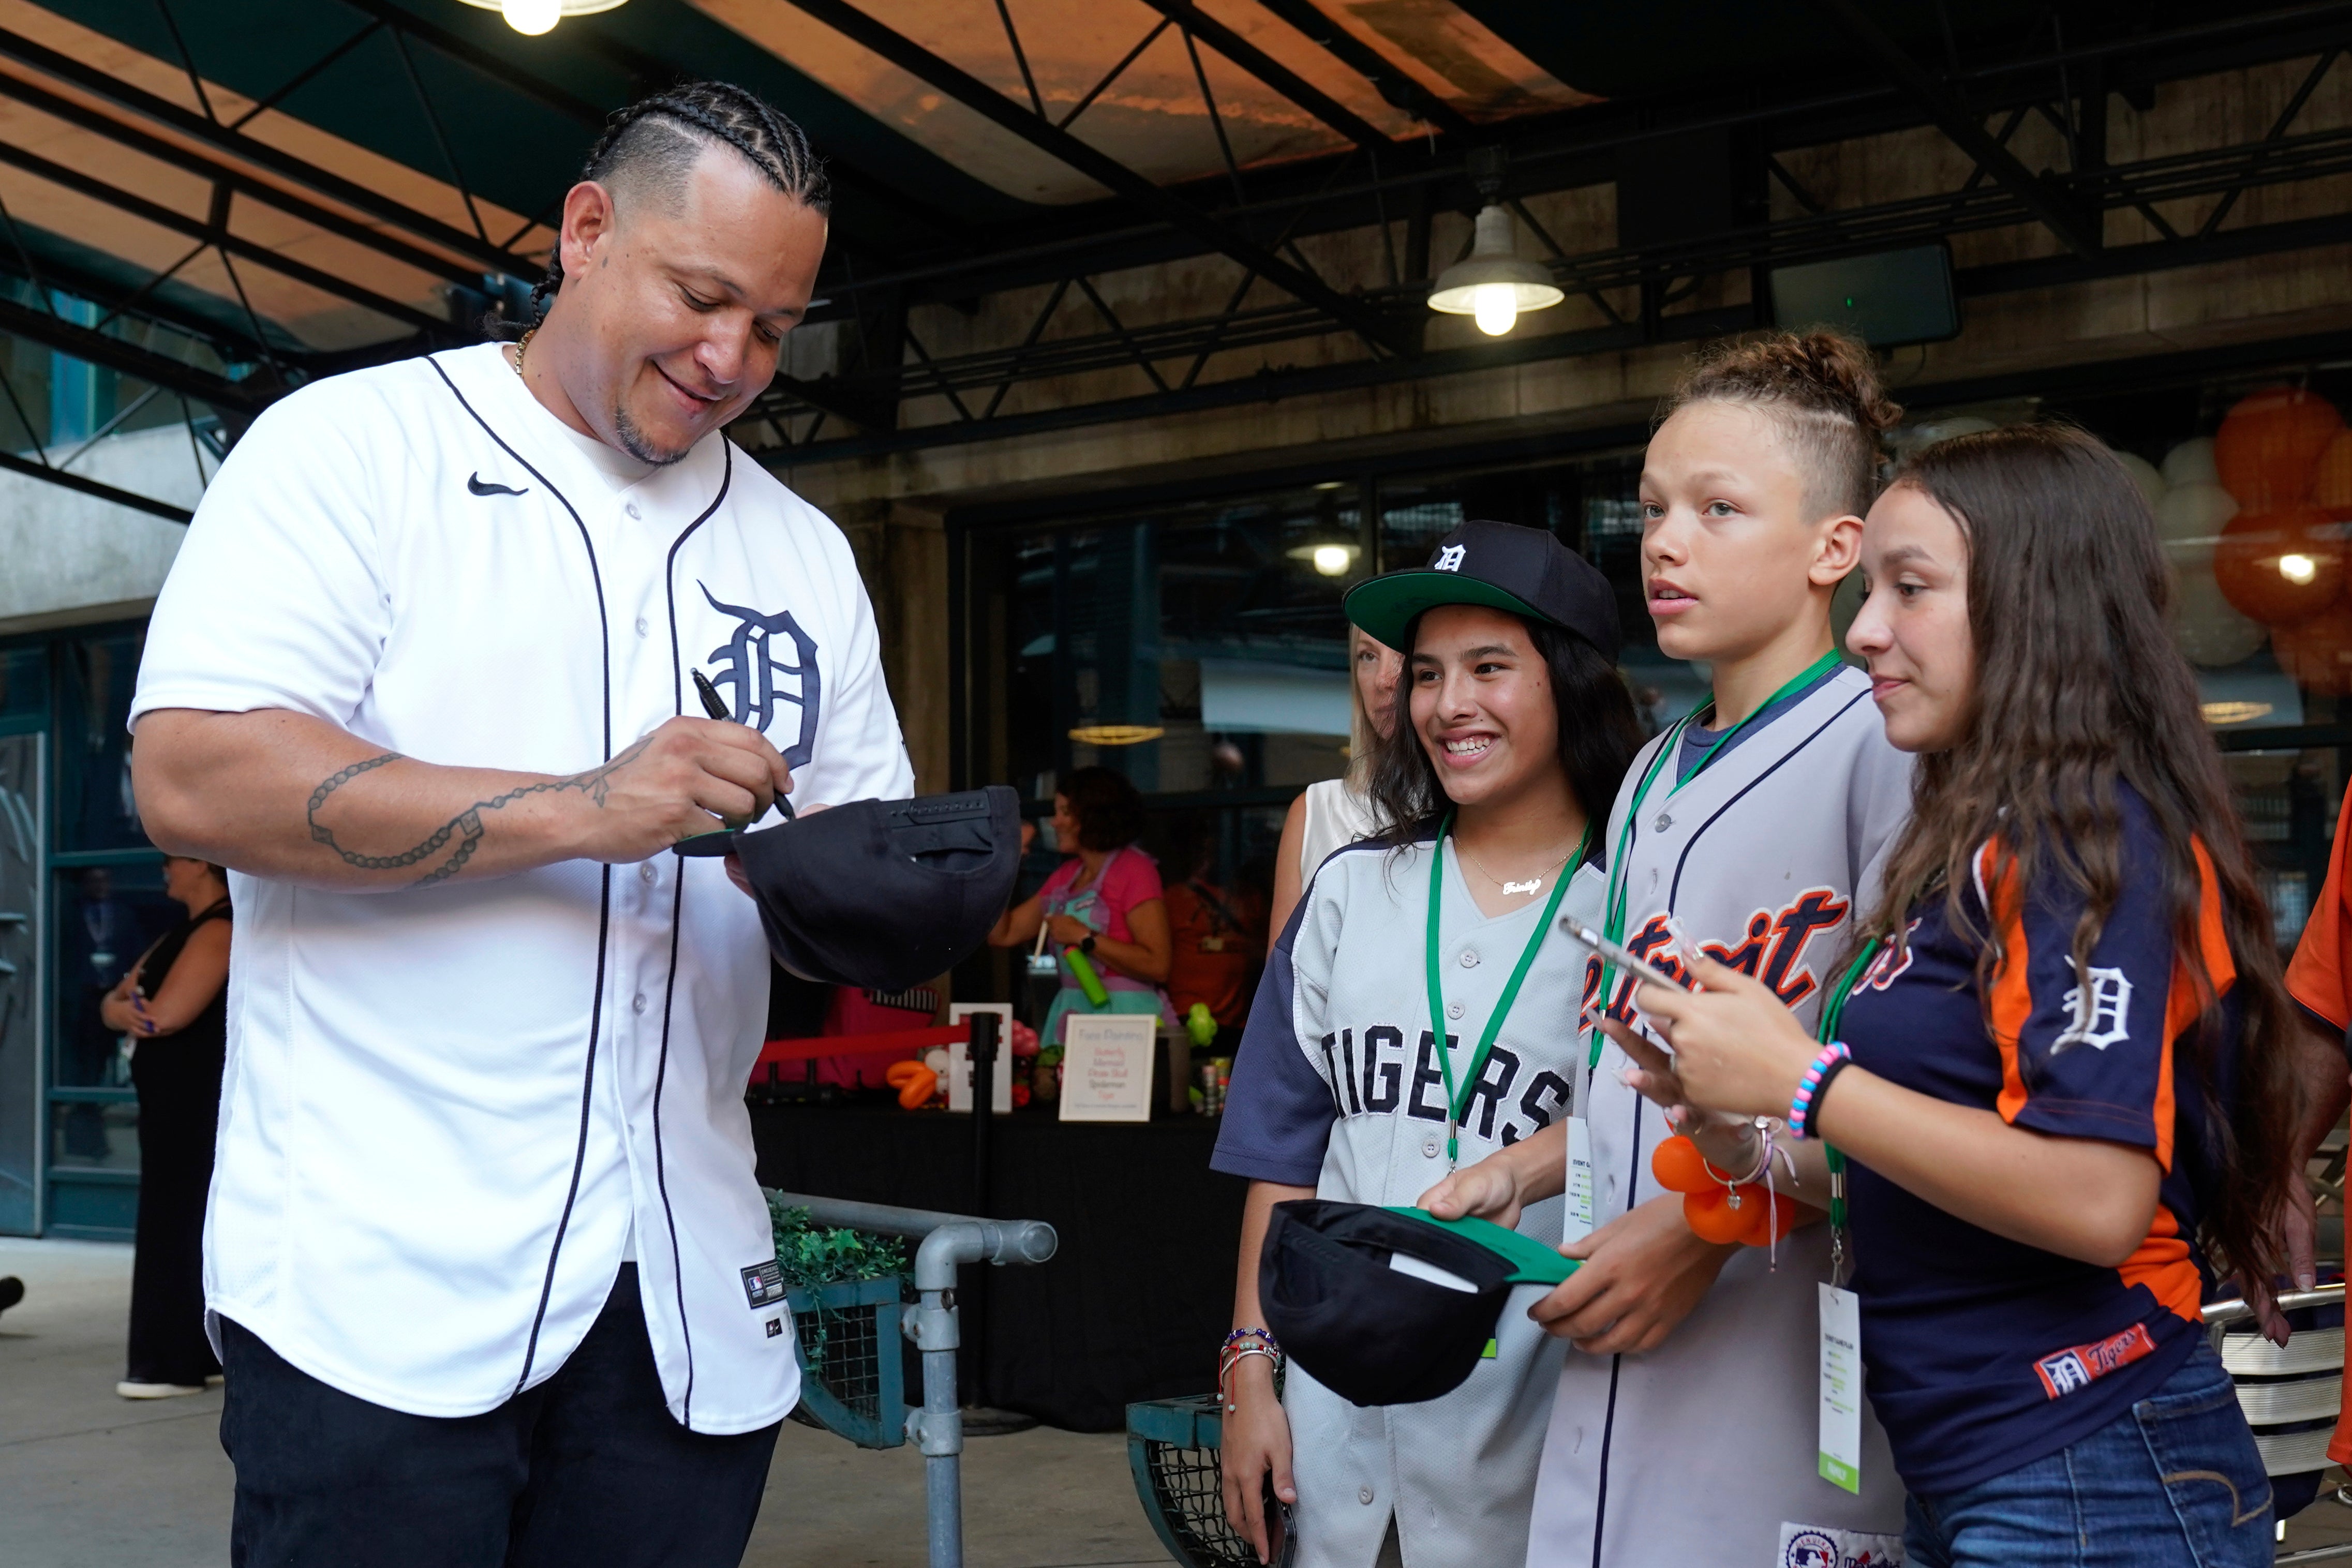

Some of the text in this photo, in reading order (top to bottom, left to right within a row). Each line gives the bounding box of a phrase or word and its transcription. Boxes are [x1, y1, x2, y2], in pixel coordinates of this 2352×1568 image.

[696, 579, 821, 771] D
[2050, 954, 2135, 1055] D
[1321, 1022, 1571, 1148] TIGERS
[1573, 1159, 1586, 1168] EVENT
[1796, 1536, 1831, 1551] GENUINE
